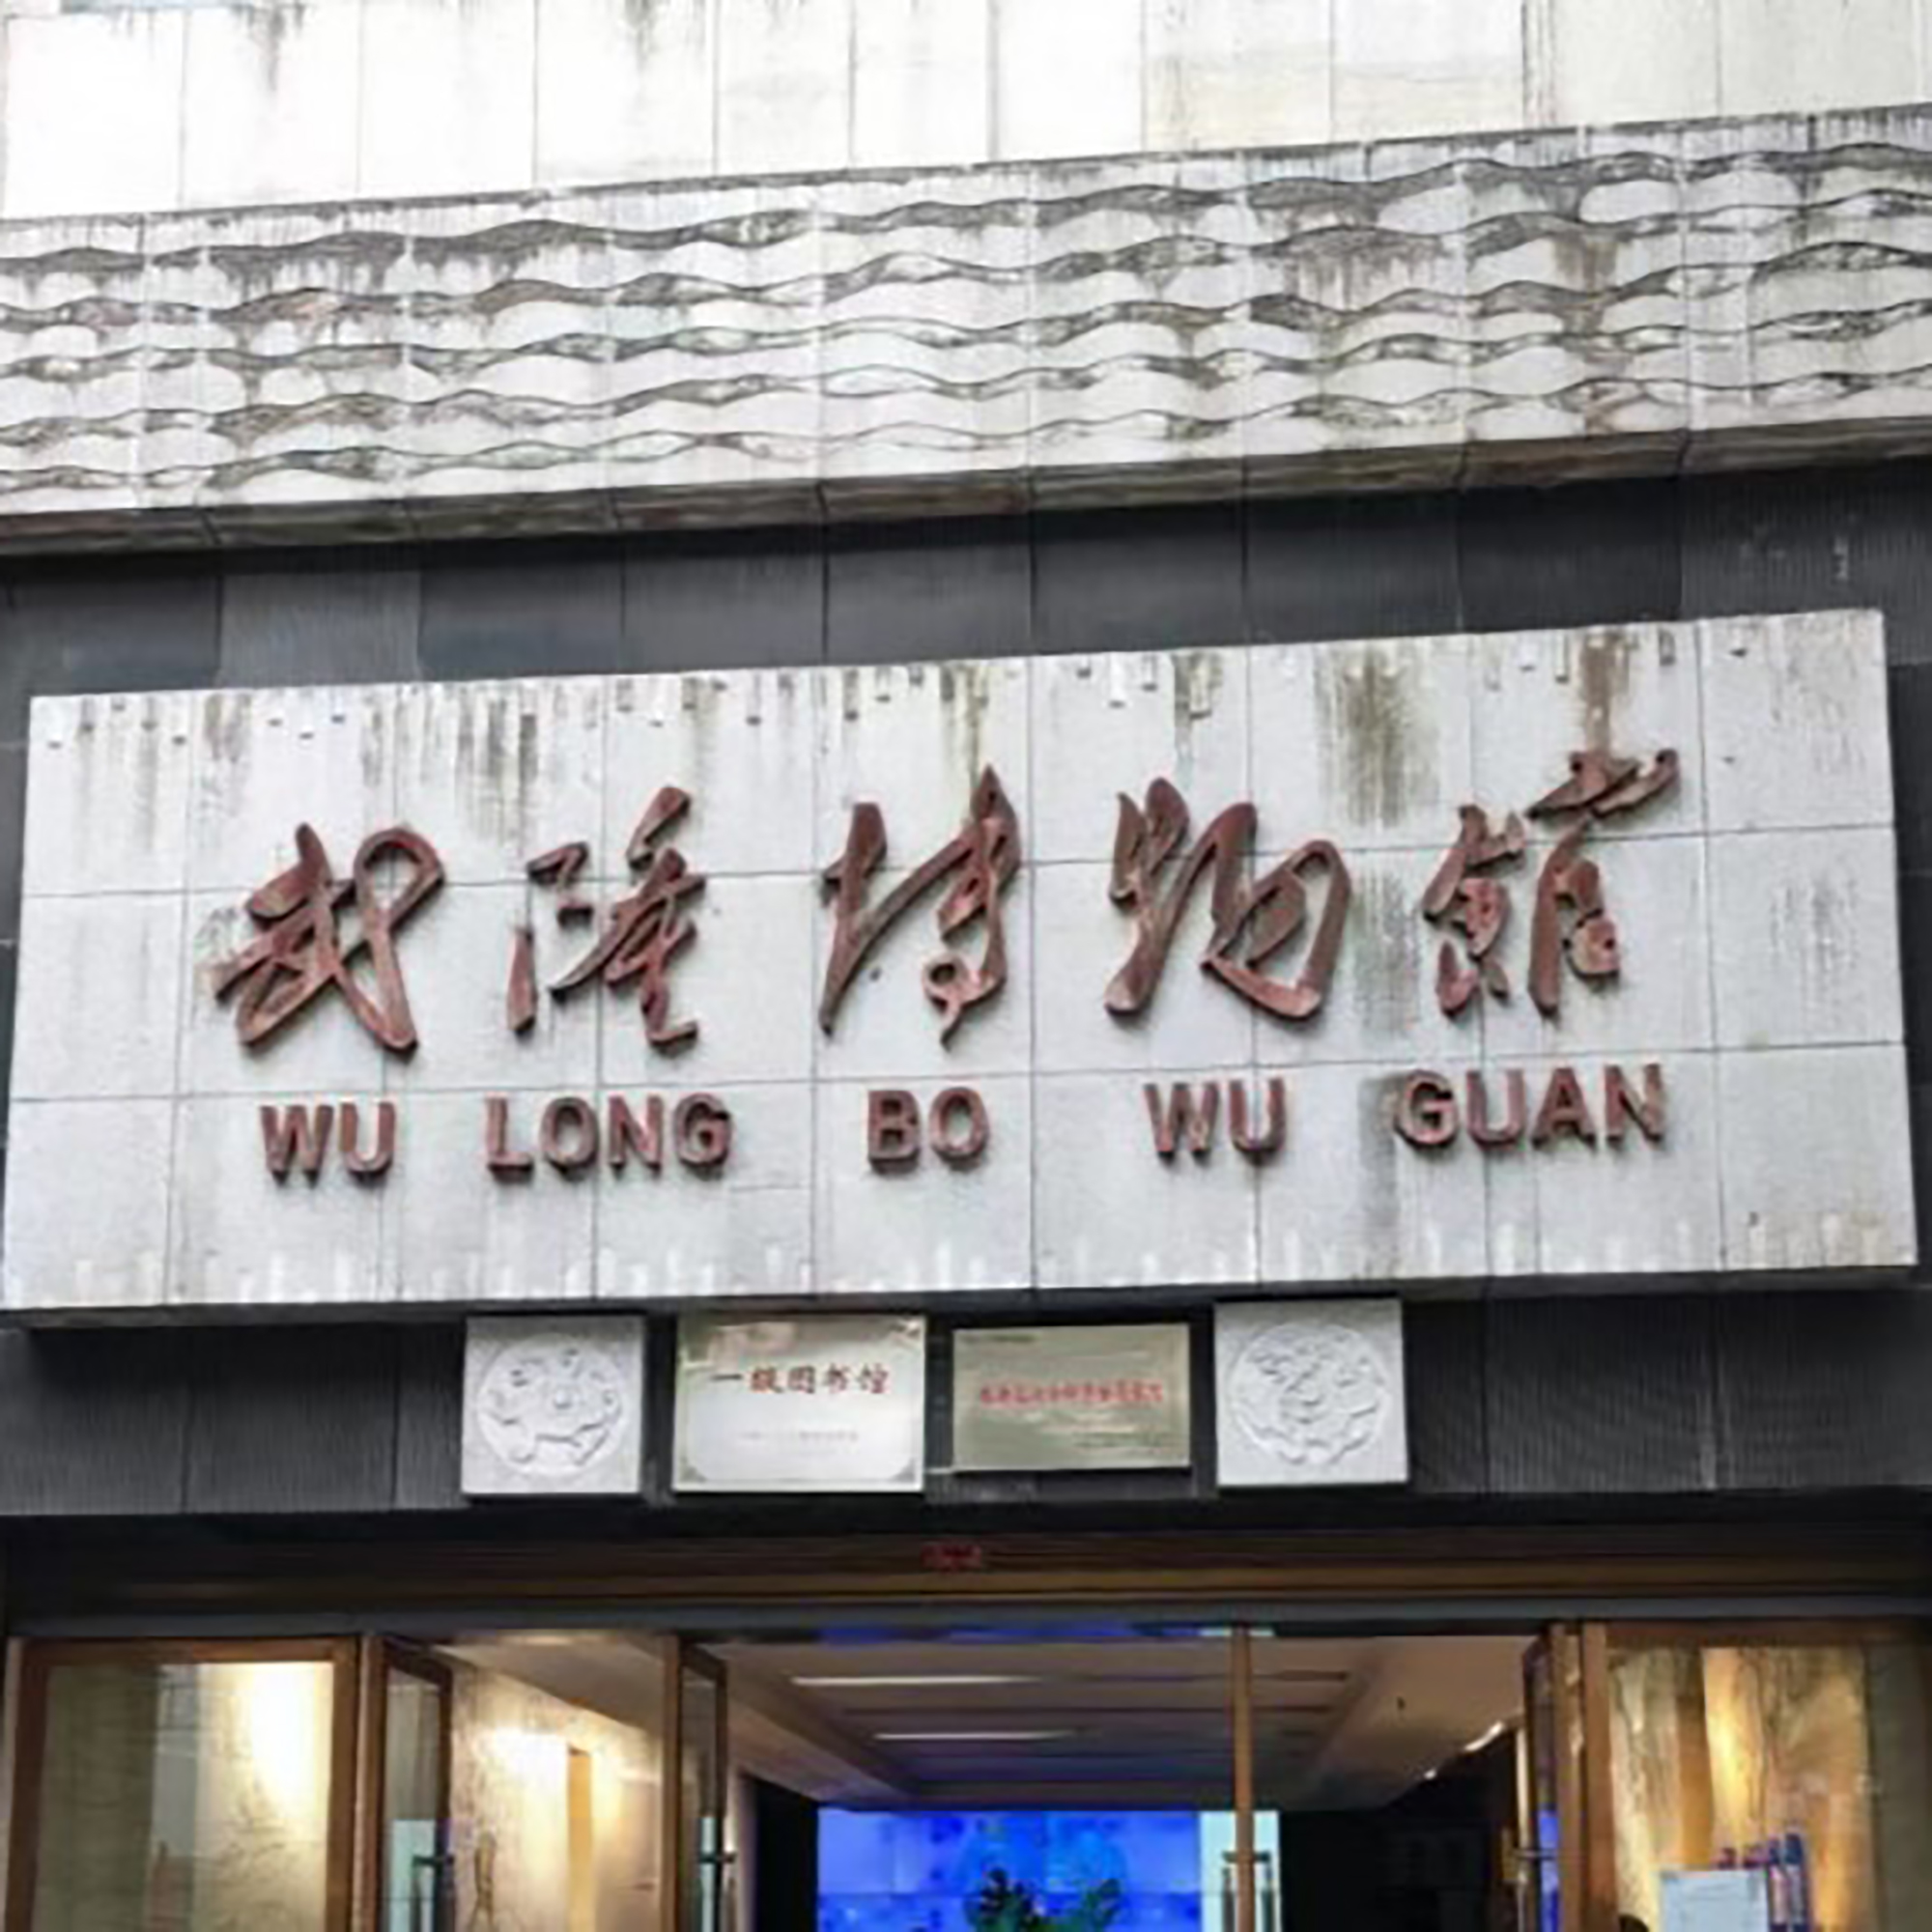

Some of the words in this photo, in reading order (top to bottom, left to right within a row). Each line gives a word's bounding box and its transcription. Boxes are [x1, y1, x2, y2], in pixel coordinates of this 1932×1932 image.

[259, 1099, 398, 1184] WU
[484, 1091, 734, 1181] LONG
[867, 1084, 990, 1171] BO
[1144, 1076, 1288, 1163] WU
[1395, 1062, 1666, 1152] GUAN
